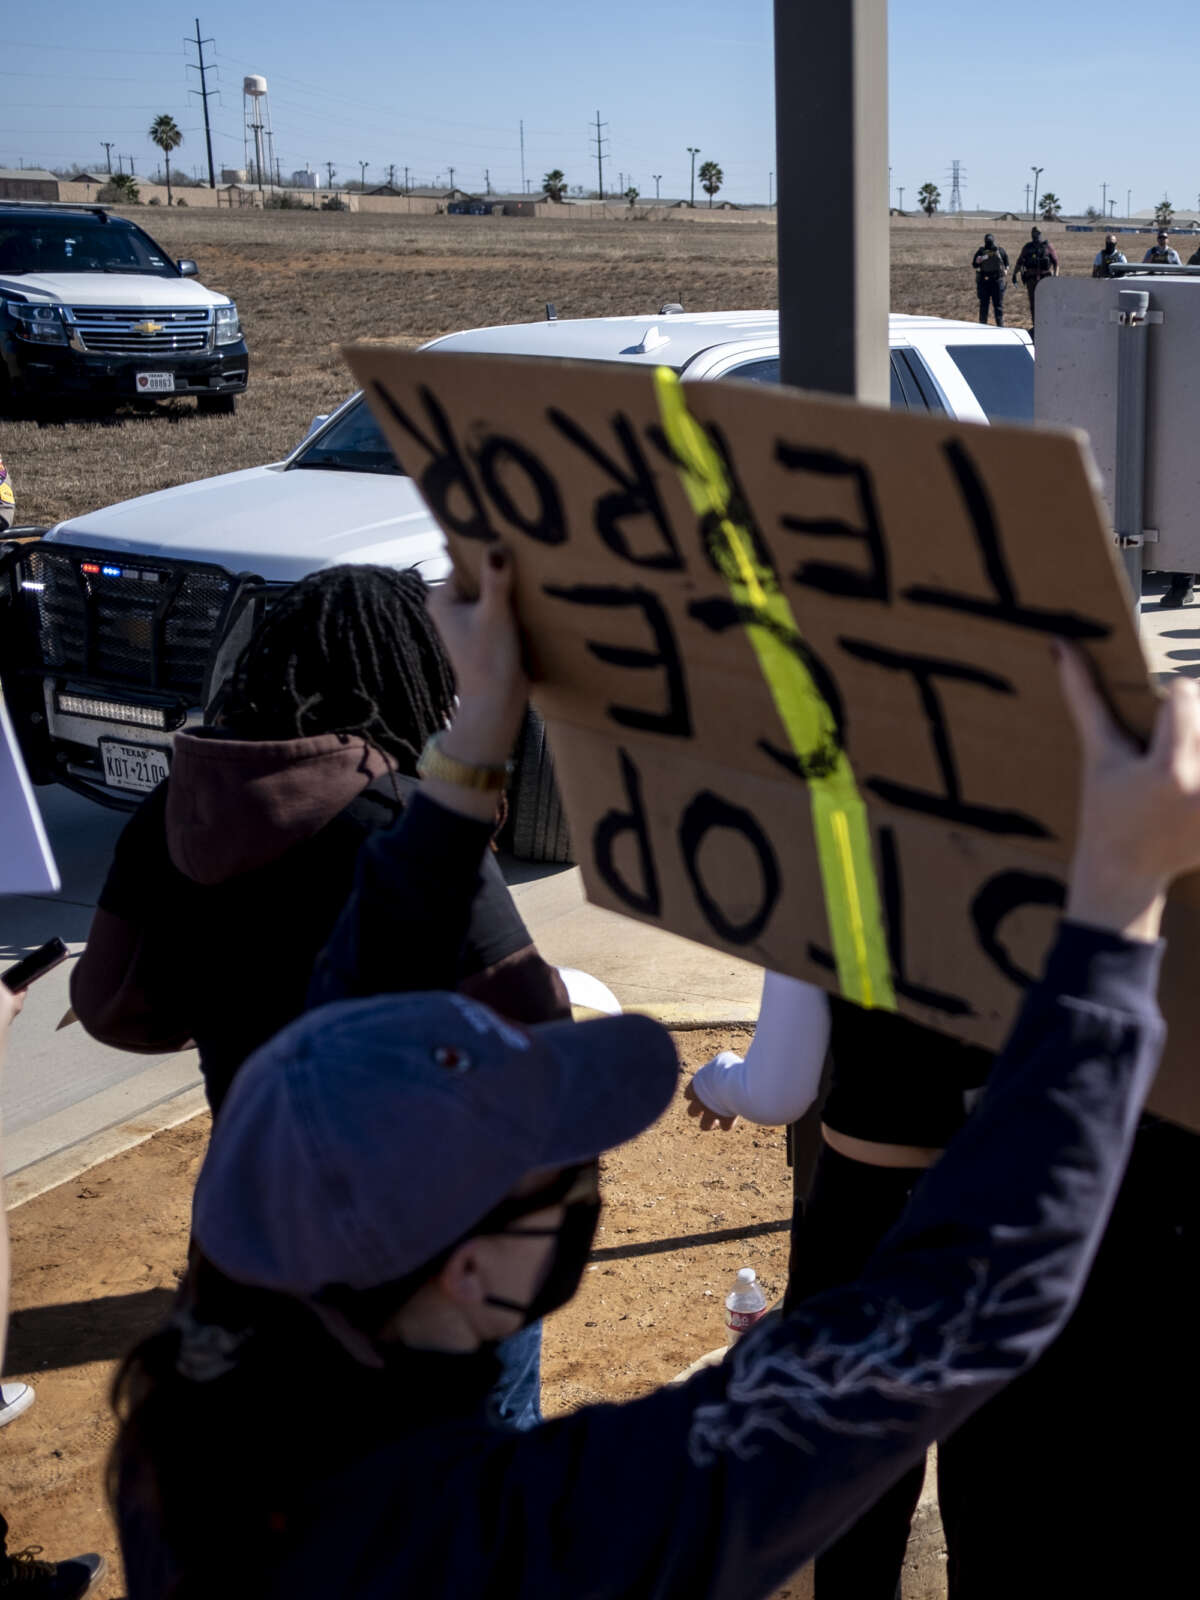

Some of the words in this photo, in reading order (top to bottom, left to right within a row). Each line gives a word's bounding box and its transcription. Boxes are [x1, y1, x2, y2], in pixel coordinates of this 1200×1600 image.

[374, 381, 1109, 639] TERROR
[121, 747, 148, 758] TEXAS
[546, 585, 1053, 837] ICE
